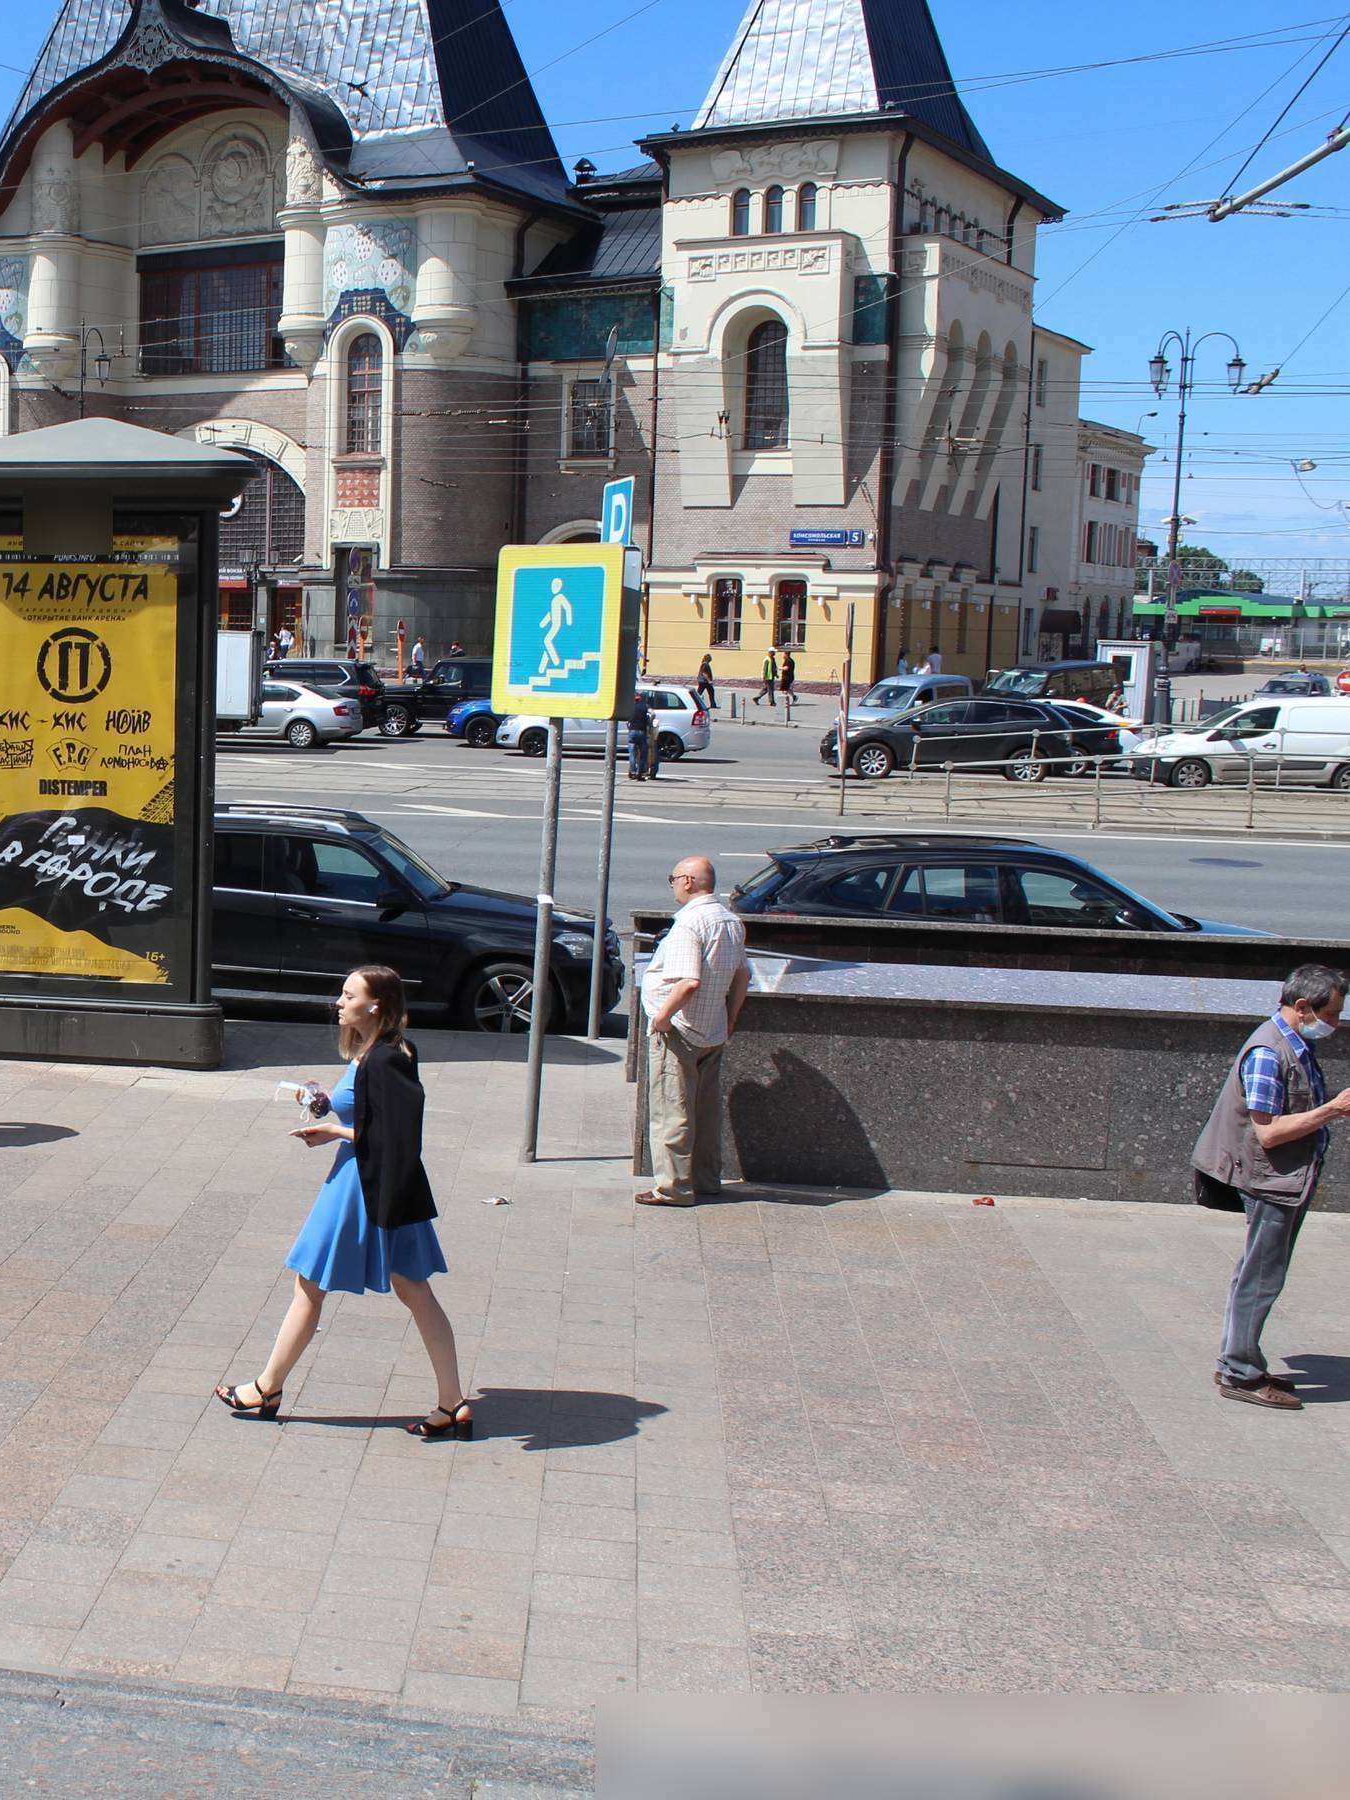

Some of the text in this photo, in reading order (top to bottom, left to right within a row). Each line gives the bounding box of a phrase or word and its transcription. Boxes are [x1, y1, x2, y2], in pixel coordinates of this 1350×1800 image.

[851, 532, 859, 542] 5
[2, 571, 149, 608] 14 АВГУСТА
[39, 779, 108, 797] DISTEMPER
